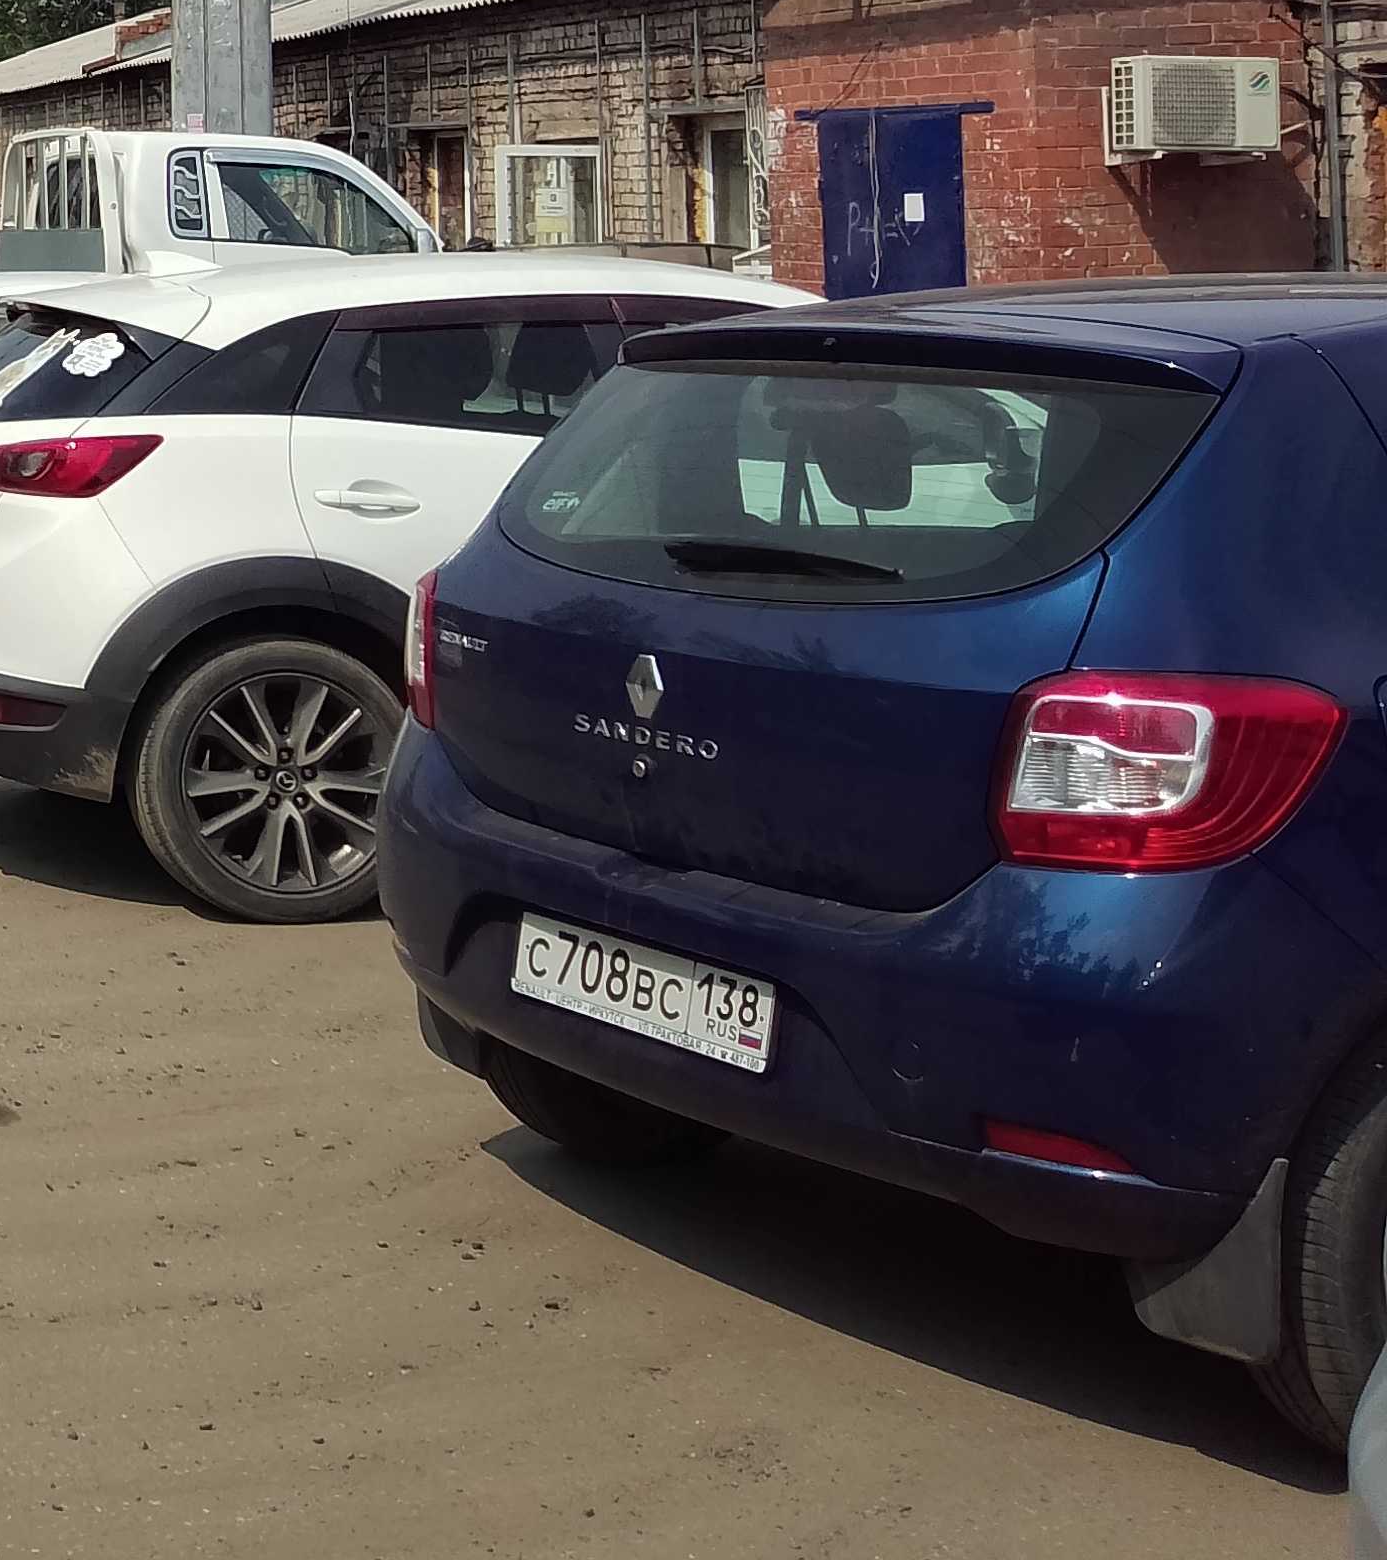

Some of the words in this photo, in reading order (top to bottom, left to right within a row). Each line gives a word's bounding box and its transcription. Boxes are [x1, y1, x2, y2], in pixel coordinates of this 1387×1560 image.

[573, 712, 720, 761] SANDERO
[527, 929, 685, 1021] С708ВС
[696, 972, 760, 1028] 138
[705, 1017, 739, 1043] RUS
